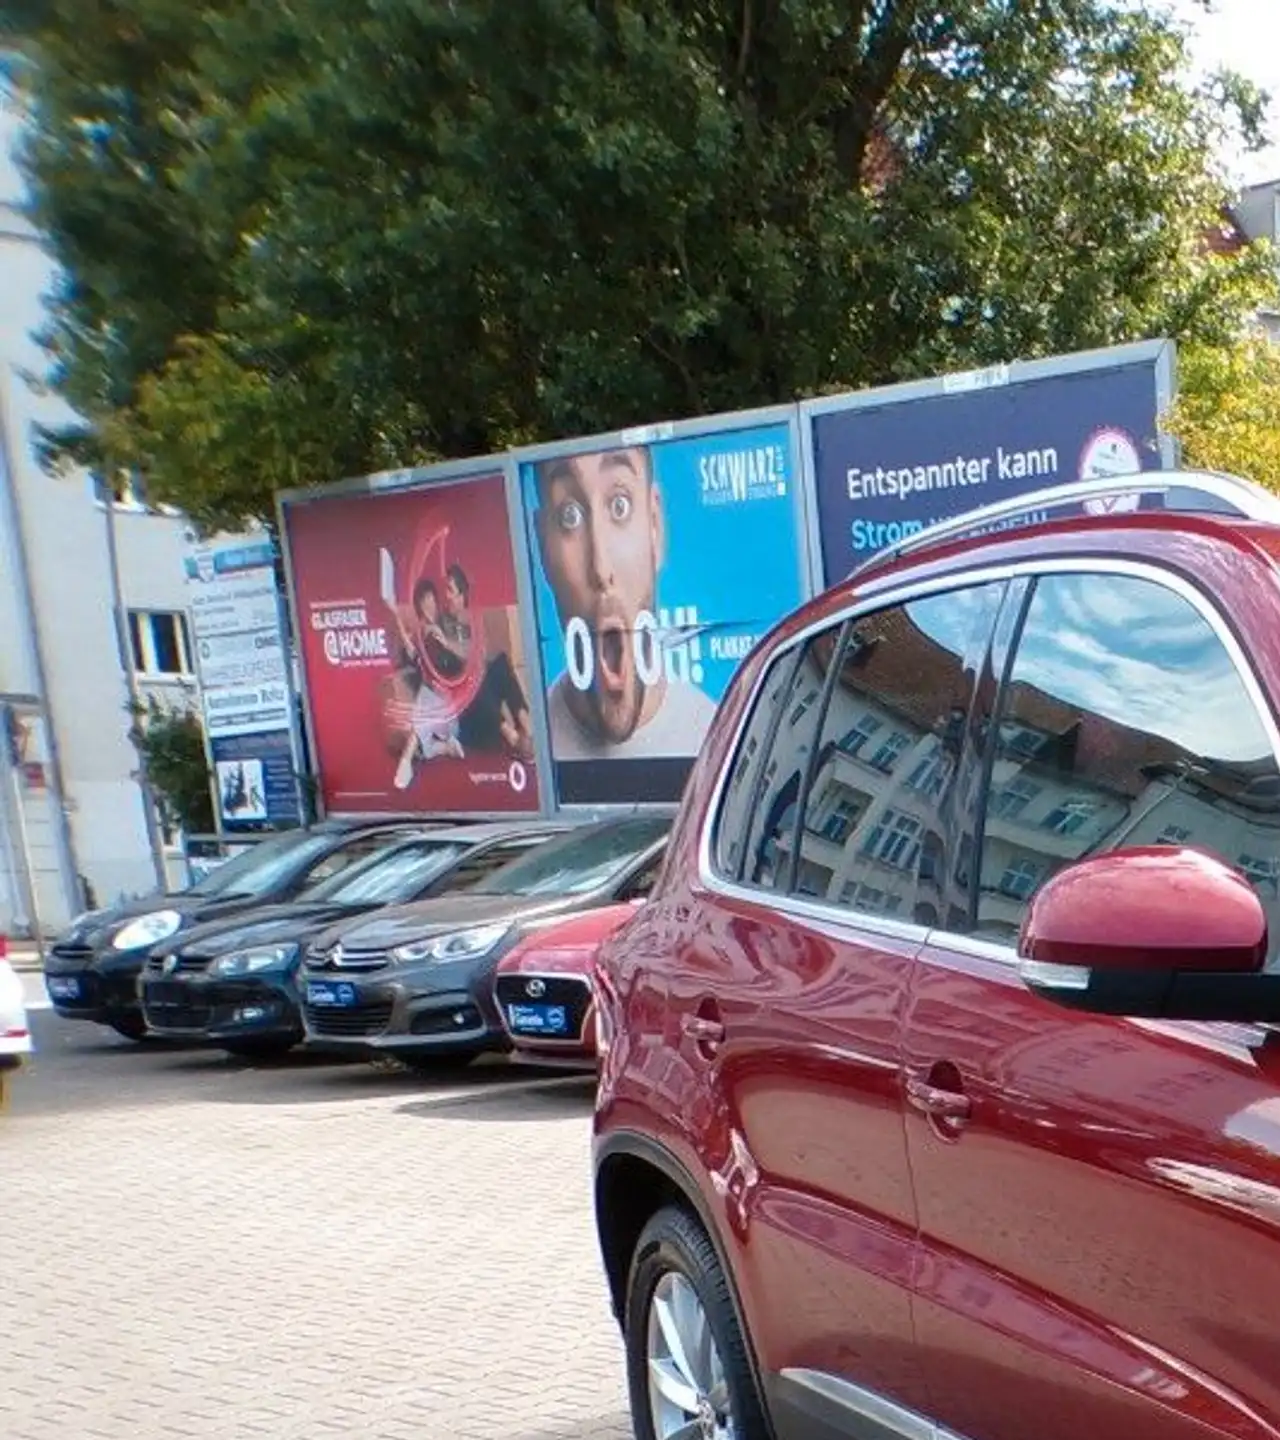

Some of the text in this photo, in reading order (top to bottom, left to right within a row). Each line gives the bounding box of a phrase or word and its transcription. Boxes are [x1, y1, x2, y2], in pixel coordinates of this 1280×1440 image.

[700, 447, 776, 501] SCHWARZ
[847, 456, 992, 500] Entspannter
[998, 446, 1058, 480] kann
[852, 517, 922, 551] Strom
[324, 628, 389, 665] @HOME
